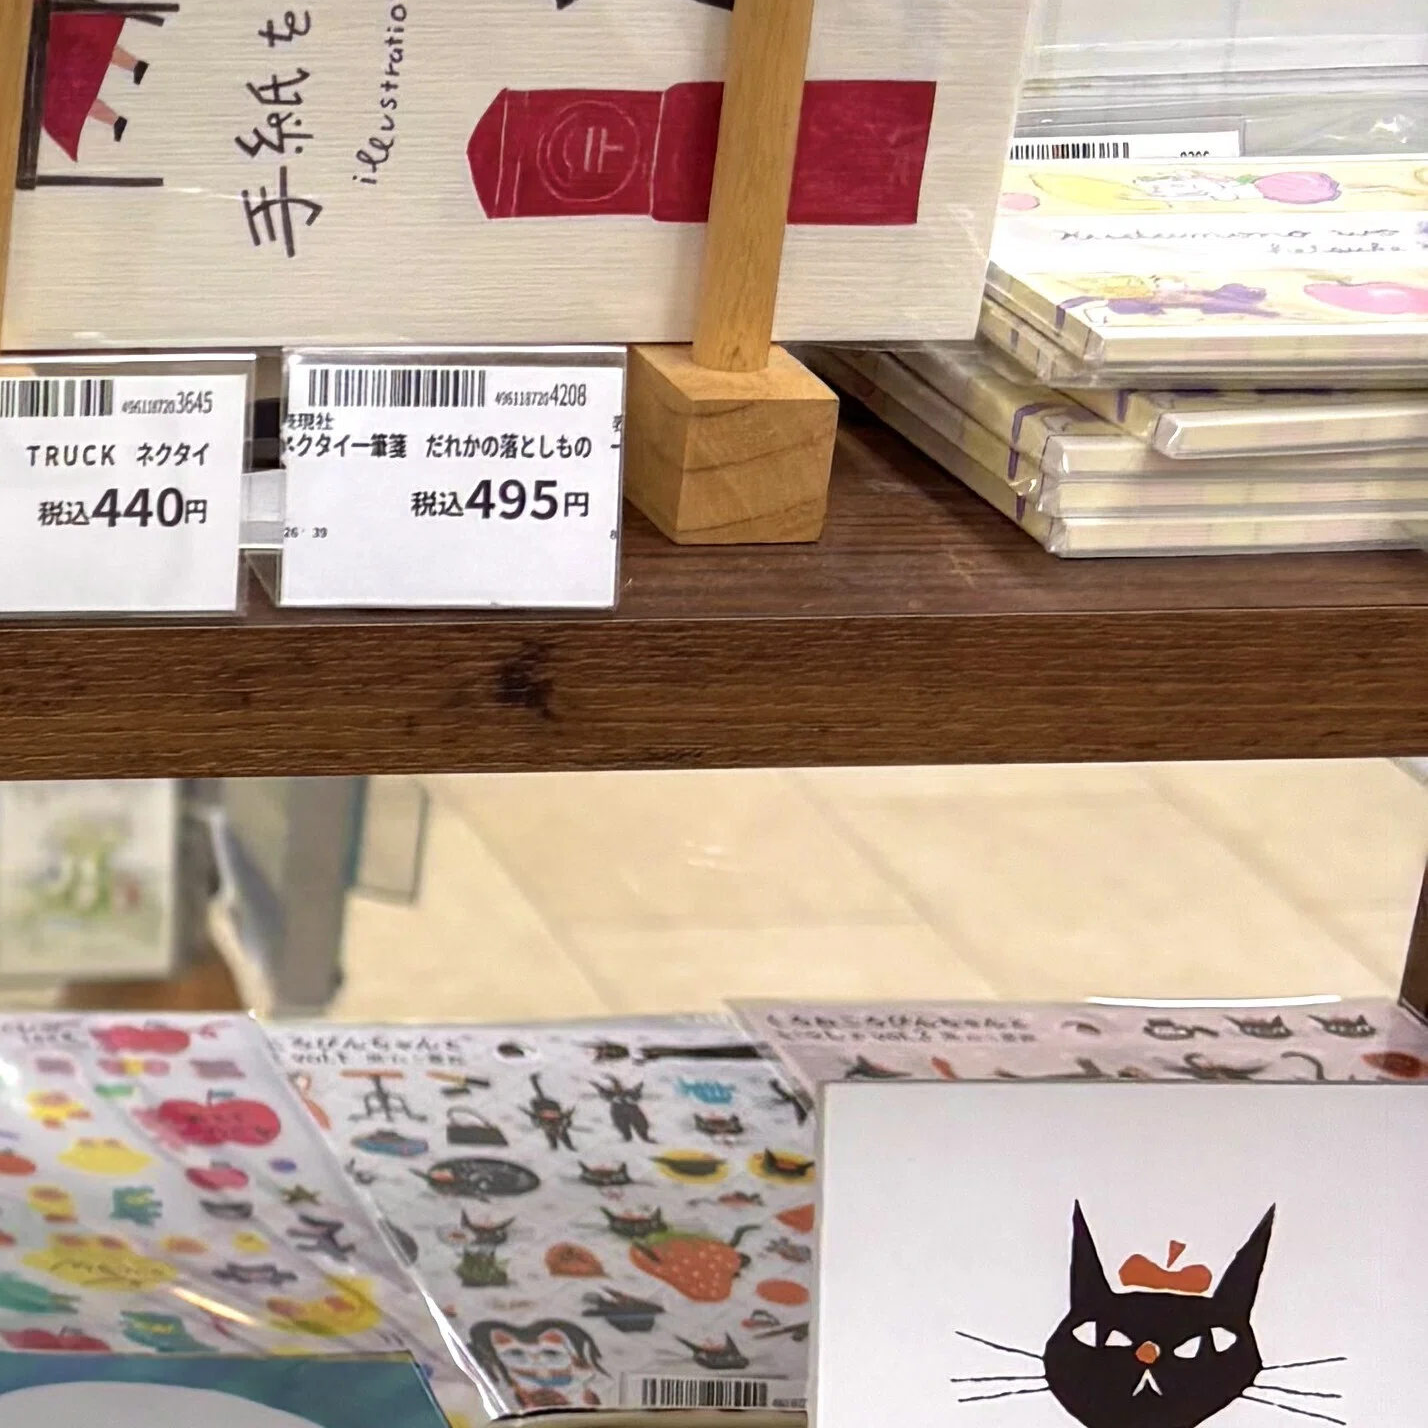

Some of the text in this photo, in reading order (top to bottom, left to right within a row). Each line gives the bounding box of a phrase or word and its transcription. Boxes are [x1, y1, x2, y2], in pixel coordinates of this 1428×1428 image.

[26, 444, 117, 466] TRUCK
[136, 443, 209, 466] ネクタイ
[426, 434, 591, 459] だれかの落としもの
[38, 487, 207, 527] 税込440円
[411, 479, 589, 519] 税込495円
